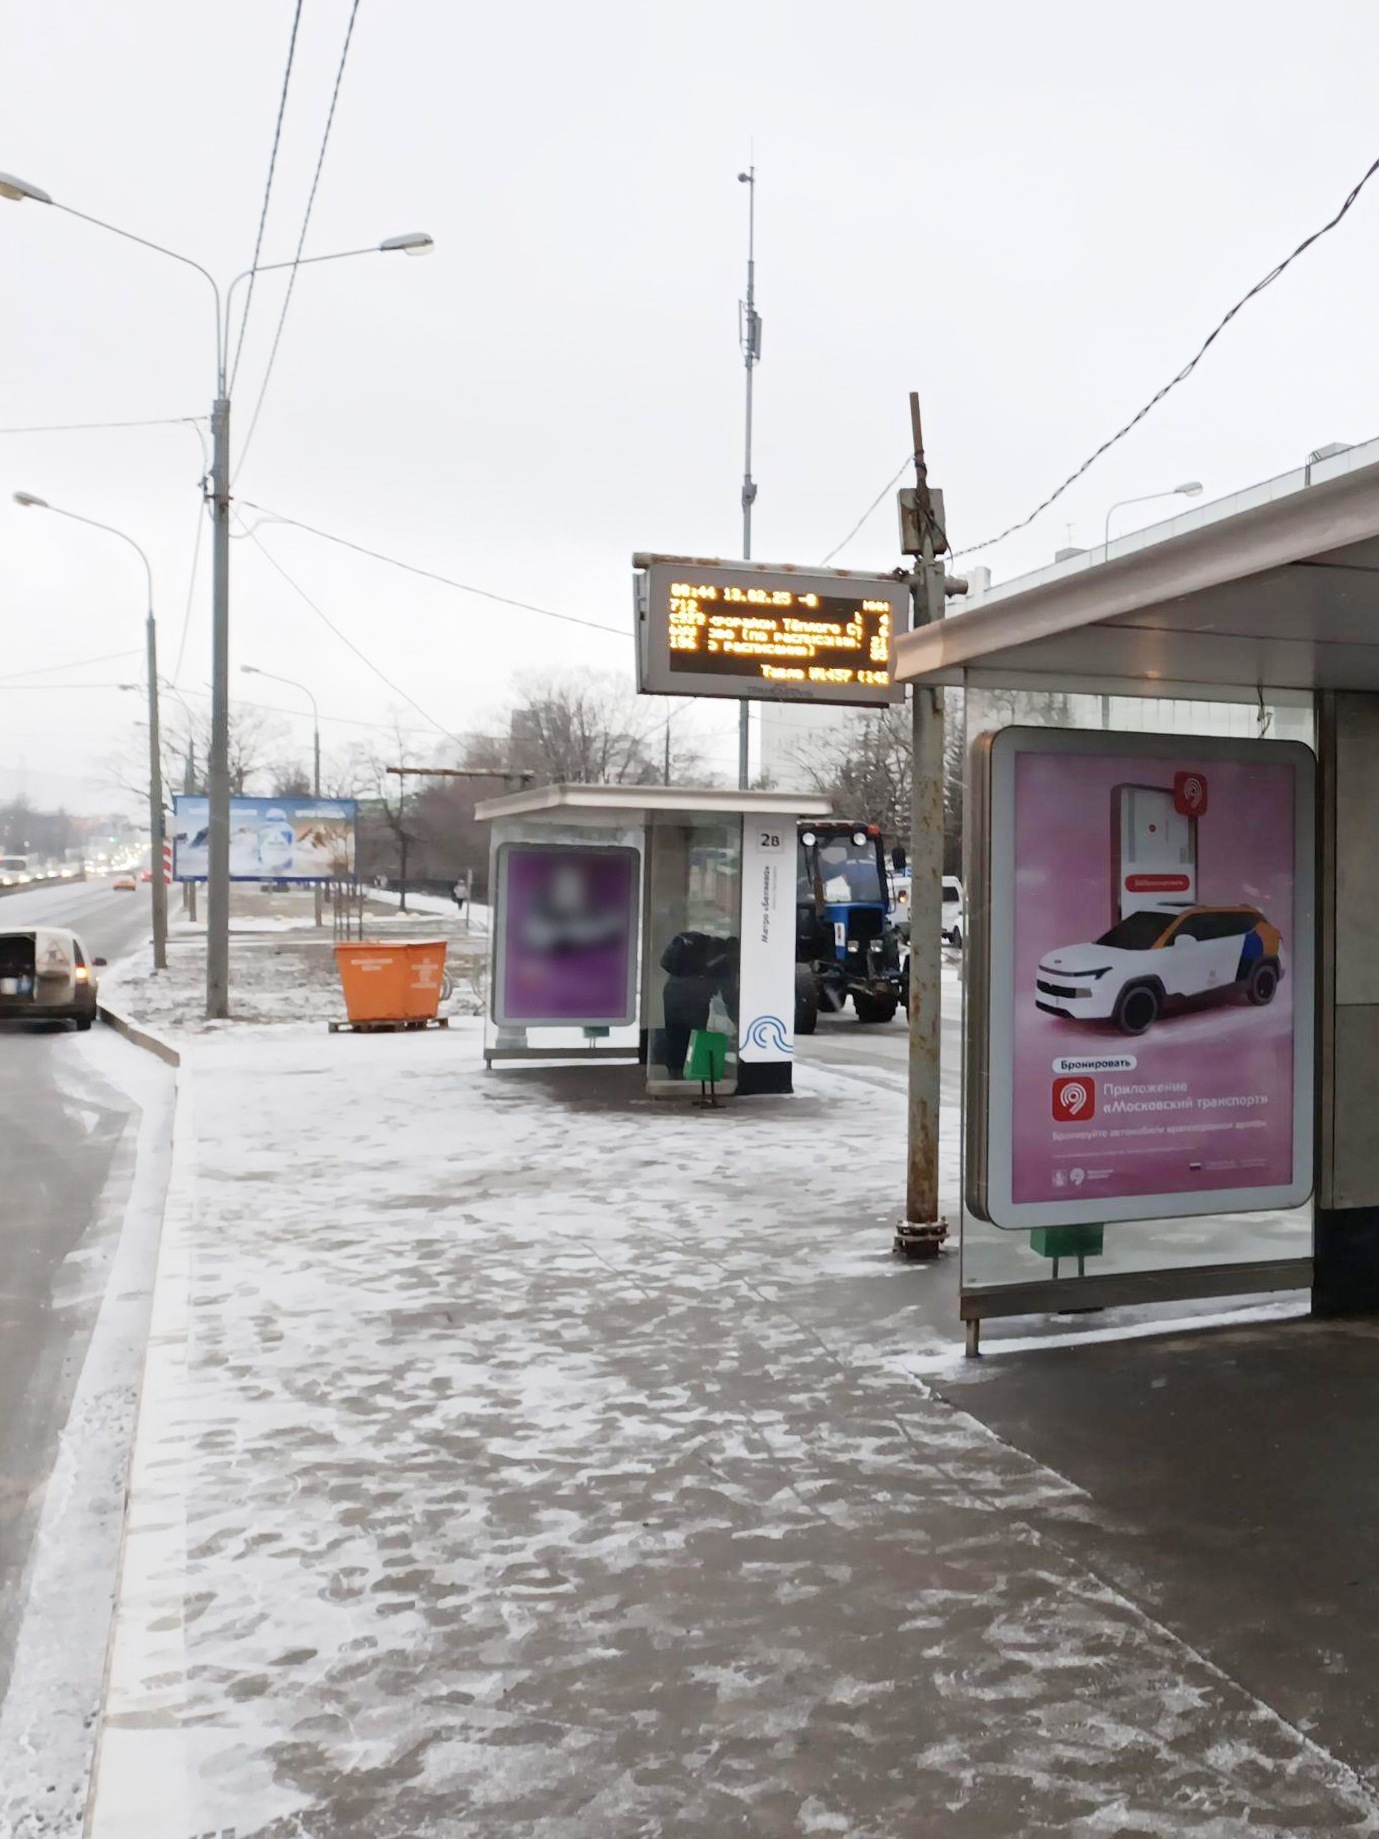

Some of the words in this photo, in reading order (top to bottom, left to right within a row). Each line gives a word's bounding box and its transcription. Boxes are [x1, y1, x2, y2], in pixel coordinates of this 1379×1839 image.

[1060, 1059, 1131, 1071] Бронировать
[1103, 1082, 1188, 1098] Приложение
[1103, 1098, 1194, 1115] «Московский
[1197, 1096, 1269, 1110] транспорт»
